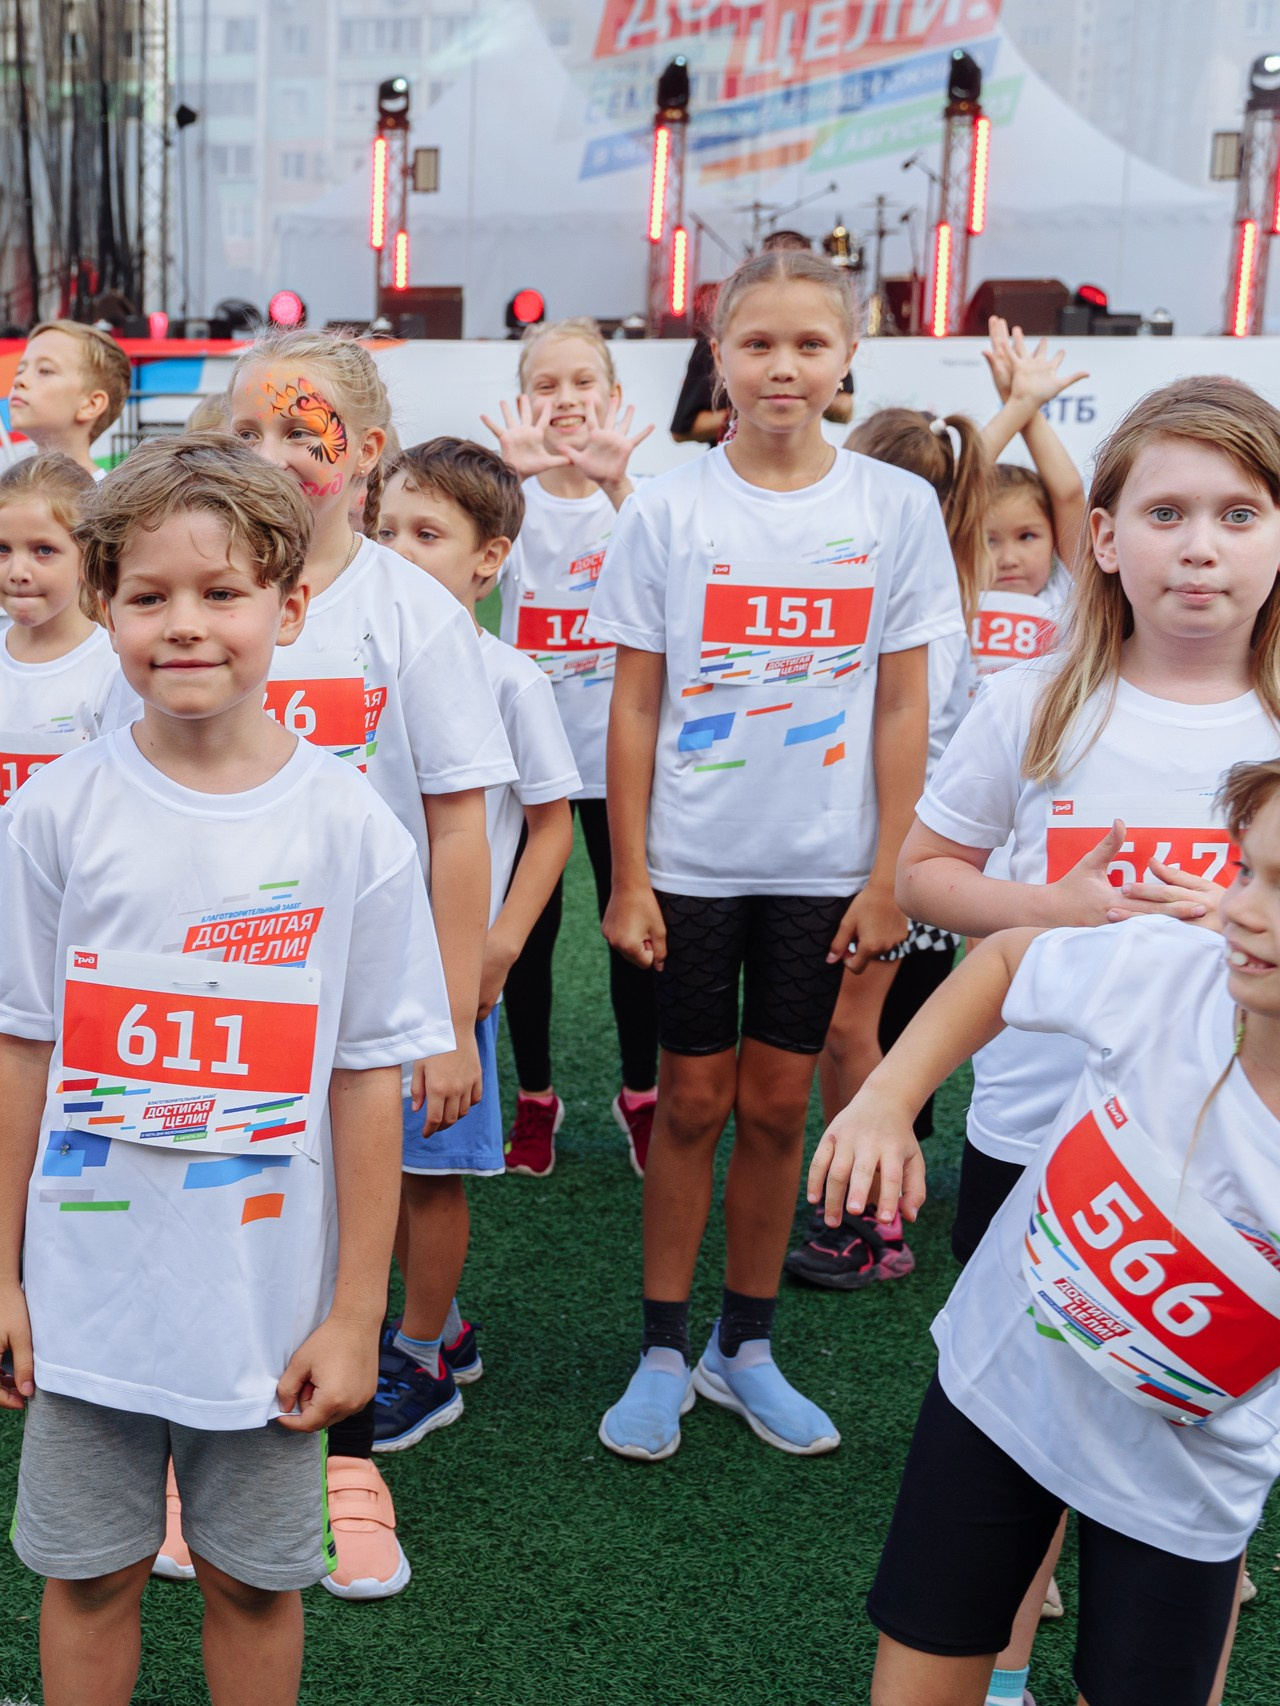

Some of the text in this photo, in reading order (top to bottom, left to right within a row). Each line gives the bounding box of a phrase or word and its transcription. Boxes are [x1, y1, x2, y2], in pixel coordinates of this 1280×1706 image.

[546, 615, 607, 646] 14
[744, 595, 836, 639] 151
[971, 617, 1038, 655] 128
[191, 912, 315, 949] ДОСТИГАЯ
[200, 902, 302, 923] БЛАГОТВОРИТЕЛЬНЫЙ ЗАБЕГ
[227, 935, 307, 963] ЦЕЛИ!
[116, 1003, 250, 1076] 611
[145, 1101, 211, 1119] ДОСТИГАЯ
[165, 1112, 207, 1128] ЦЕЛИ!
[1071, 1181, 1223, 1338] 566
[1055, 1282, 1127, 1333] ДОСТИГАЯ
[1065, 1303, 1115, 1339] ЦЕЛИ!
